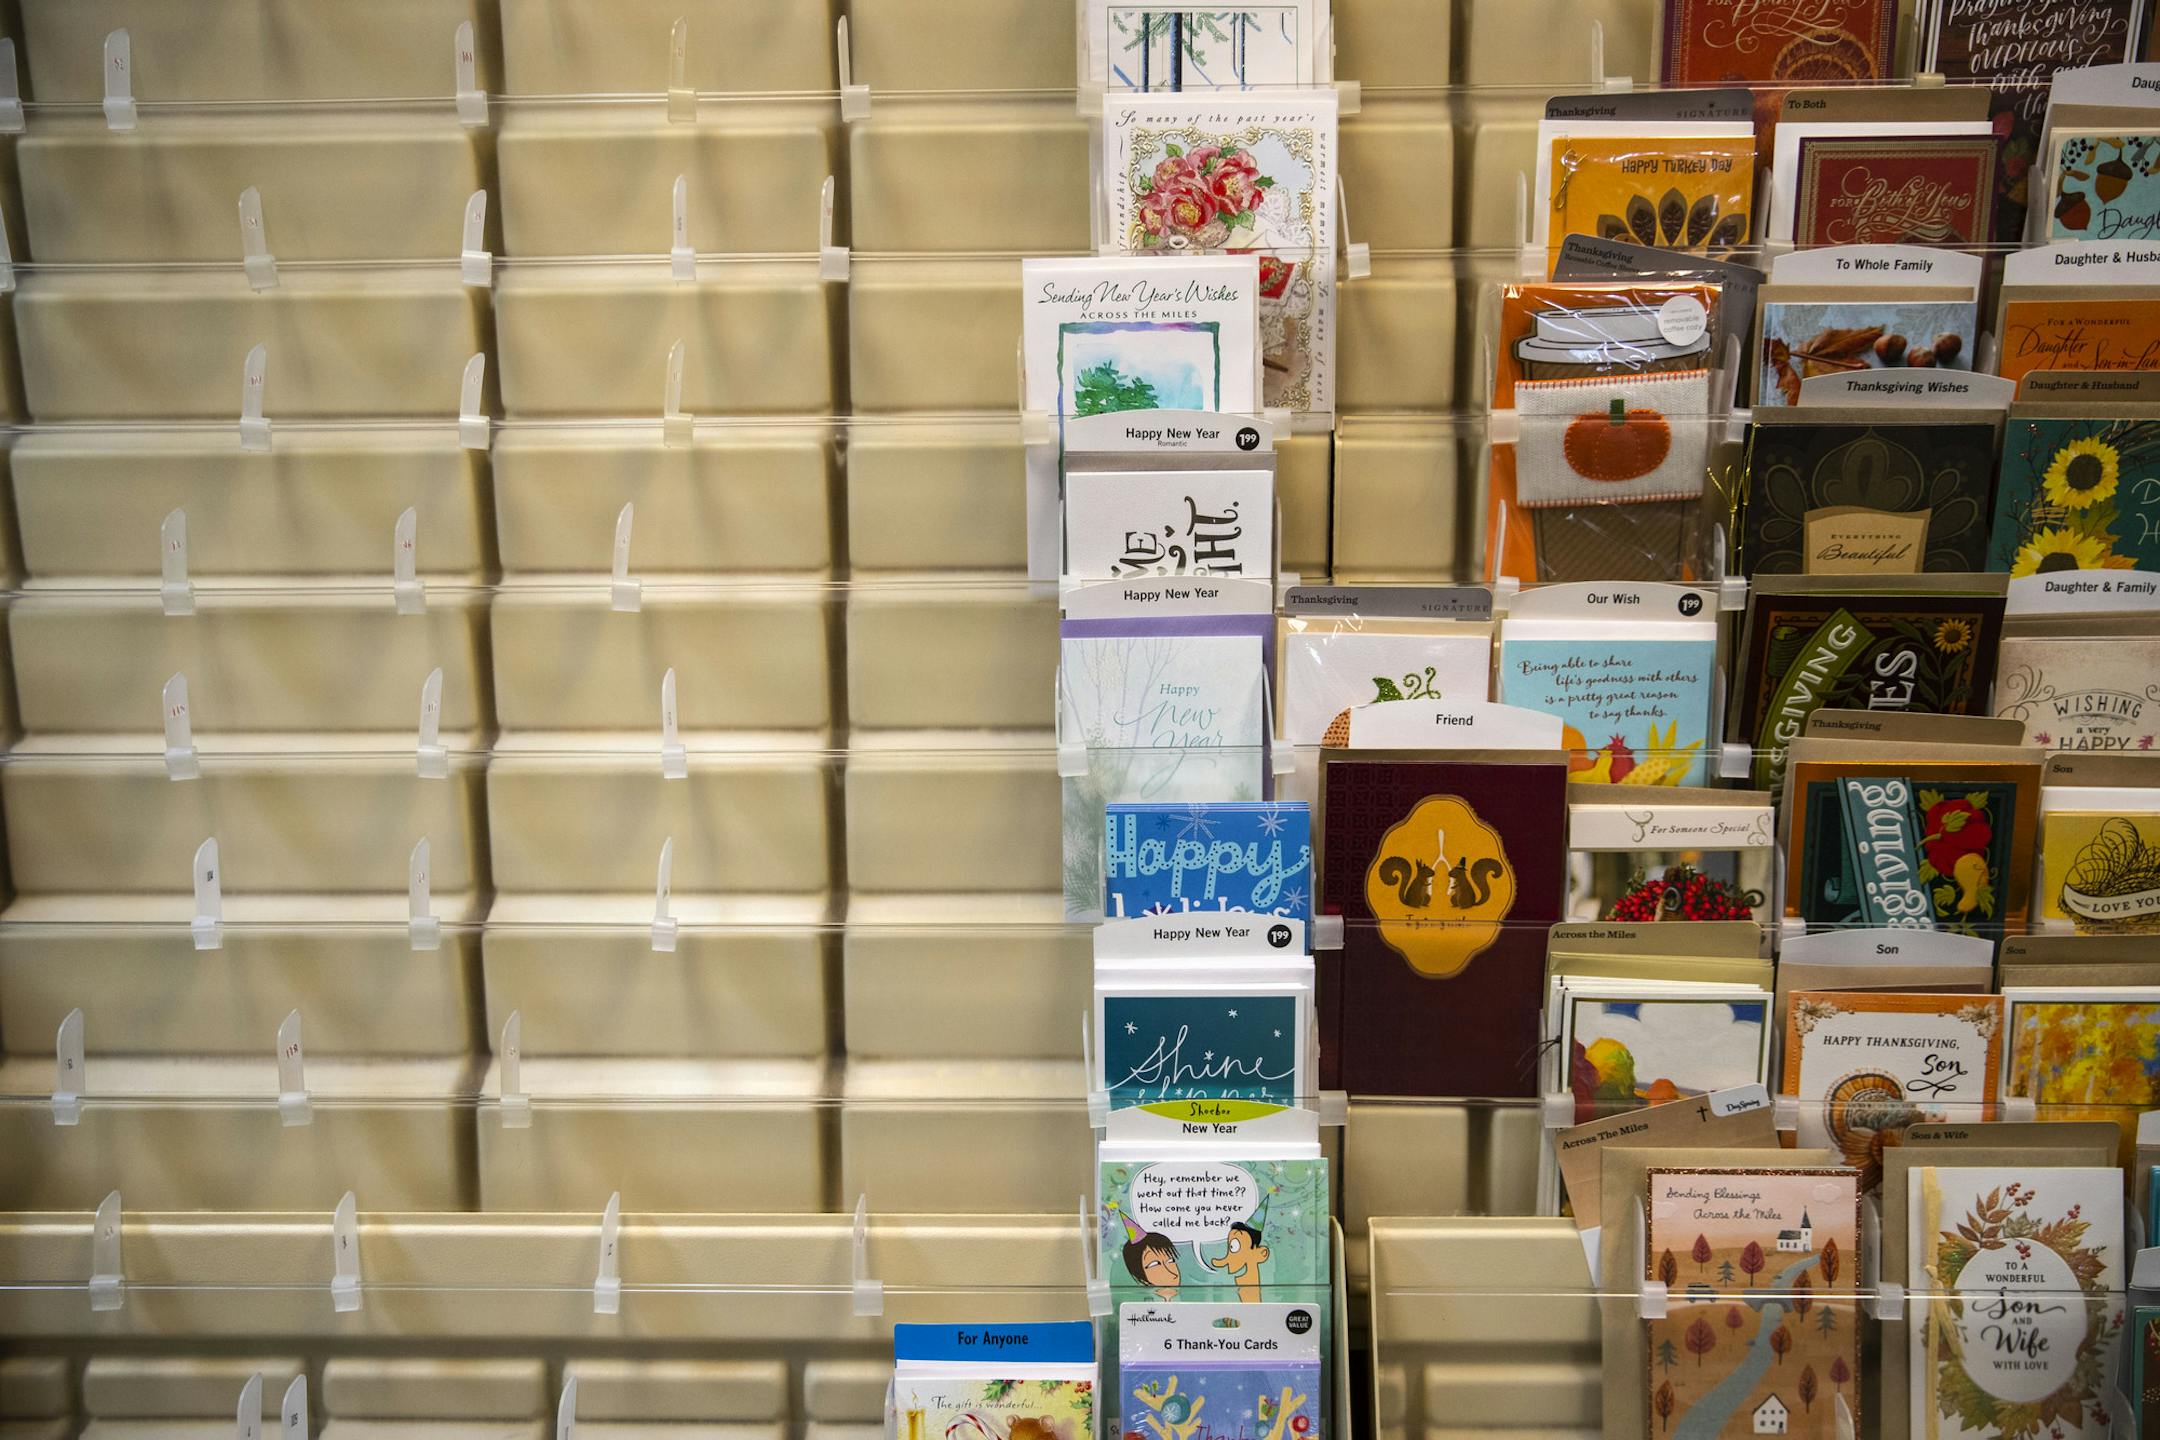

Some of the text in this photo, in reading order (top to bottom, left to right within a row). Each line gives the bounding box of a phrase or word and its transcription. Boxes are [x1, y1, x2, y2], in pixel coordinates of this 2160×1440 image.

[2132, 77, 2160, 91] Daug
[1788, 99, 1826, 109] To Both
[1116, 110, 1316, 127] So many of the past year's
[1549, 106, 1616, 118] Thanksgiving
[1676, 108, 1747, 118] SIGNATURE
[1568, 242, 1633, 263] Thanksgiving
[2055, 252, 2121, 266] Daughter &
[1837, 258, 1933, 272] To Whole Family
[1038, 280, 1239, 311] Sending New Year's Wishes
[1080, 311, 1198, 320] ACROSS THE MILES
[2010, 323, 2090, 369] Daughter
[1846, 381, 1969, 394] Thanksgiving Wishes
[2030, 381, 2140, 392] Daughter & Husband
[1126, 428, 1220, 441] Happy New Year
[1817, 543, 1912, 565] Beautiful
[1124, 588, 1219, 602] Happy New Year
[2045, 581, 2157, 596] Daughter & Family
[1291, 595, 1358, 606] Thanksgiving
[1587, 592, 1640, 604] Our Wish
[1421, 604, 1490, 613] SIGNATURE
[1517, 656, 1632, 676] Being able to share
[1556, 671, 1698, 692] life's goodness with others
[1160, 684, 1199, 697] Happy
[1545, 695, 1554, 705] is
[1568, 690, 1603, 706] pretty
[1606, 690, 1636, 705] great
[1640, 690, 1679, 700] reason
[2054, 695, 2143, 718] WISHING
[1436, 714, 1474, 726] Friend
[1589, 705, 1668, 724] to say thanks.
[1812, 719, 1882, 732] Thanksgiving
[2088, 727, 2111, 735] very
[2059, 737, 2131, 750] HAPPY
[2053, 764, 2073, 774] Son
[1650, 822, 1750, 835] For Someone Special
[1107, 814, 1309, 908] Happy
[2092, 901, 2131, 913] LOVE
[1154, 926, 1251, 941] Happy New Year
[1552, 930, 1636, 939] Across the Miles
[1876, 944, 1899, 955] Son
[2006, 947, 2026, 955] Son
[1823, 1035, 1960, 1050] HAPPY THANKSGIVING,
[1105, 1025, 1296, 1091] Shine
[1922, 1053, 1968, 1076] Son
[1190, 1102, 1231, 1117] Shoebox
[1182, 1123, 1237, 1134] New Year
[1562, 1122, 1649, 1150] Across The Miles
[1911, 1131, 1968, 1140] Son & Wife
[1144, 1172, 1239, 1186] Hey, remember we
[1137, 1187, 1246, 1198] went out that time??
[1667, 1187, 1761, 1202] Sending Blessings
[1140, 1203, 1243, 1216] How come you never
[1694, 1208, 1782, 1220] Across the Miles
[1152, 1216, 1231, 1228] called me back?
[2005, 1261, 2028, 1270] TO A
[1986, 1274, 2046, 1283] WONDERFUL
[1972, 1287, 2066, 1319] Son
[1127, 1313, 1176, 1326] Hallmark
[2012, 1317, 2032, 1325] AND
[957, 1331, 1029, 1348] For Anyone
[1164, 1339, 1278, 1350] 6 Thank-You Cards
[1981, 1326, 2050, 1358] Wife
[1993, 1361, 2048, 1370] WITH LOVE
[932, 1396, 953, 1409] The
[955, 1401, 973, 1414] gift
[986, 1399, 1043, 1410] wonderful...
